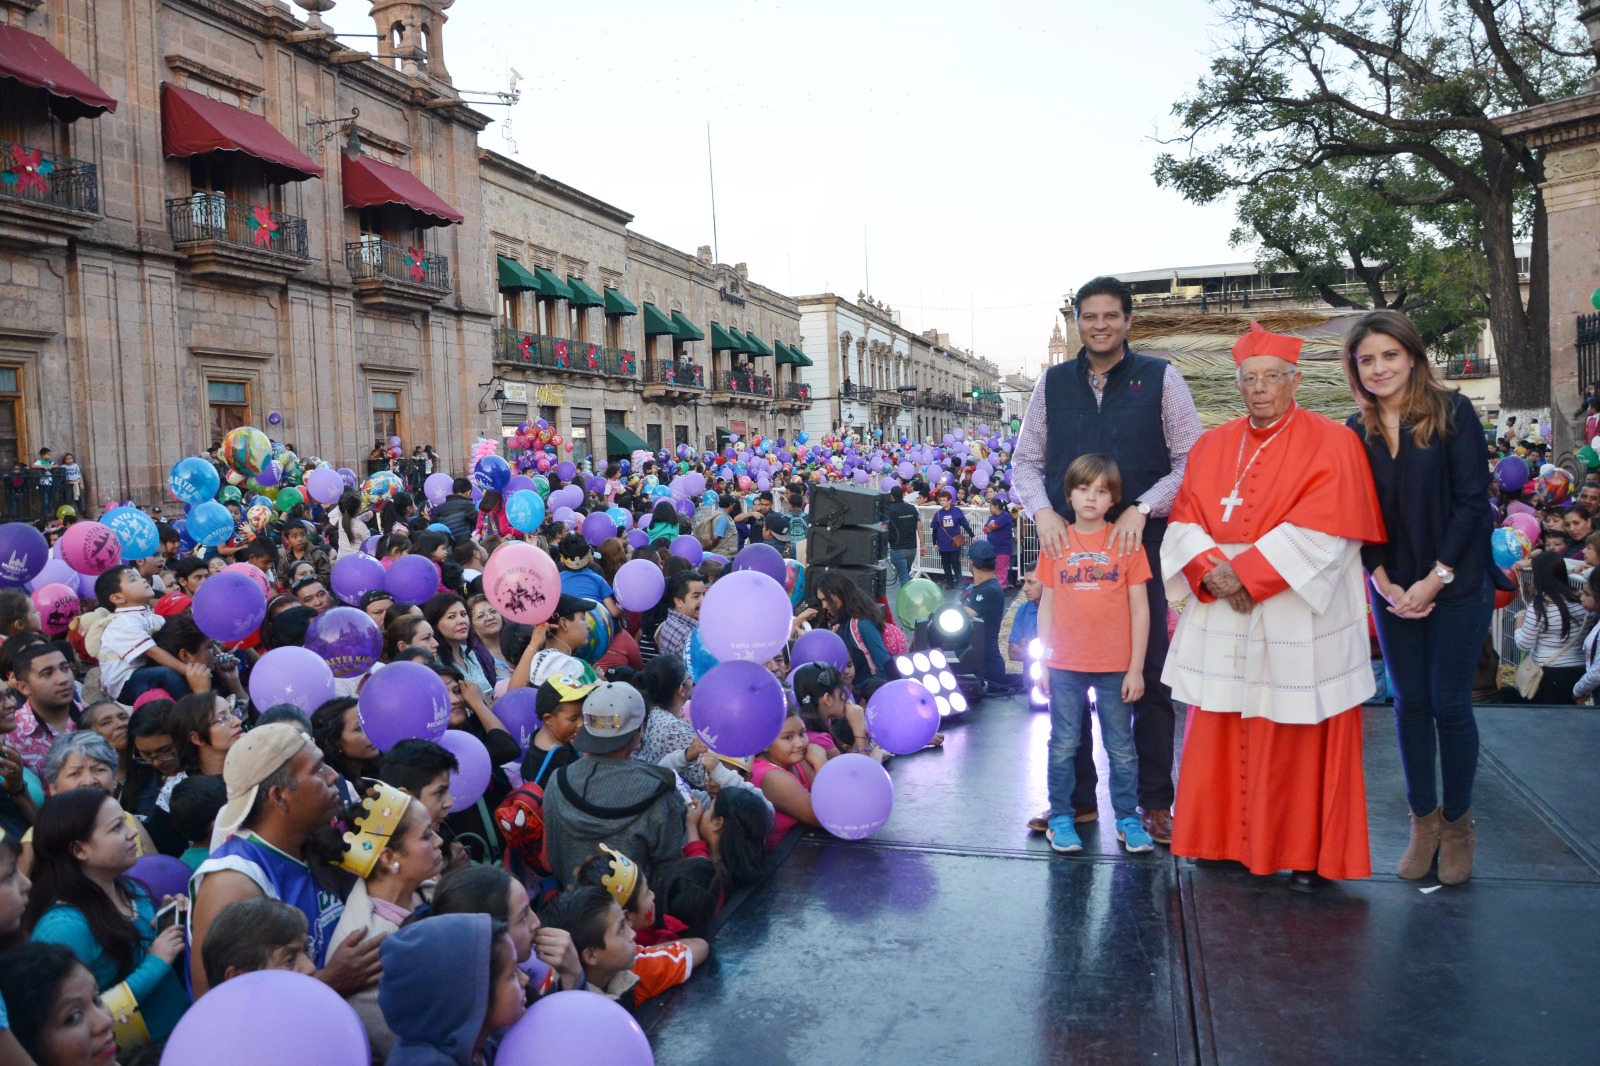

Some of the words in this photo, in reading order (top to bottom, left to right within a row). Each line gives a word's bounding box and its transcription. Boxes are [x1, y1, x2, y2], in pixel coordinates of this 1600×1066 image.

[174, 475, 196, 493] REYES
[111, 511, 132, 528] REYES
[1, 561, 28, 572] MORELIA
[1060, 568, 1083, 584] Red
[1084, 564, 1119, 583] Cek
